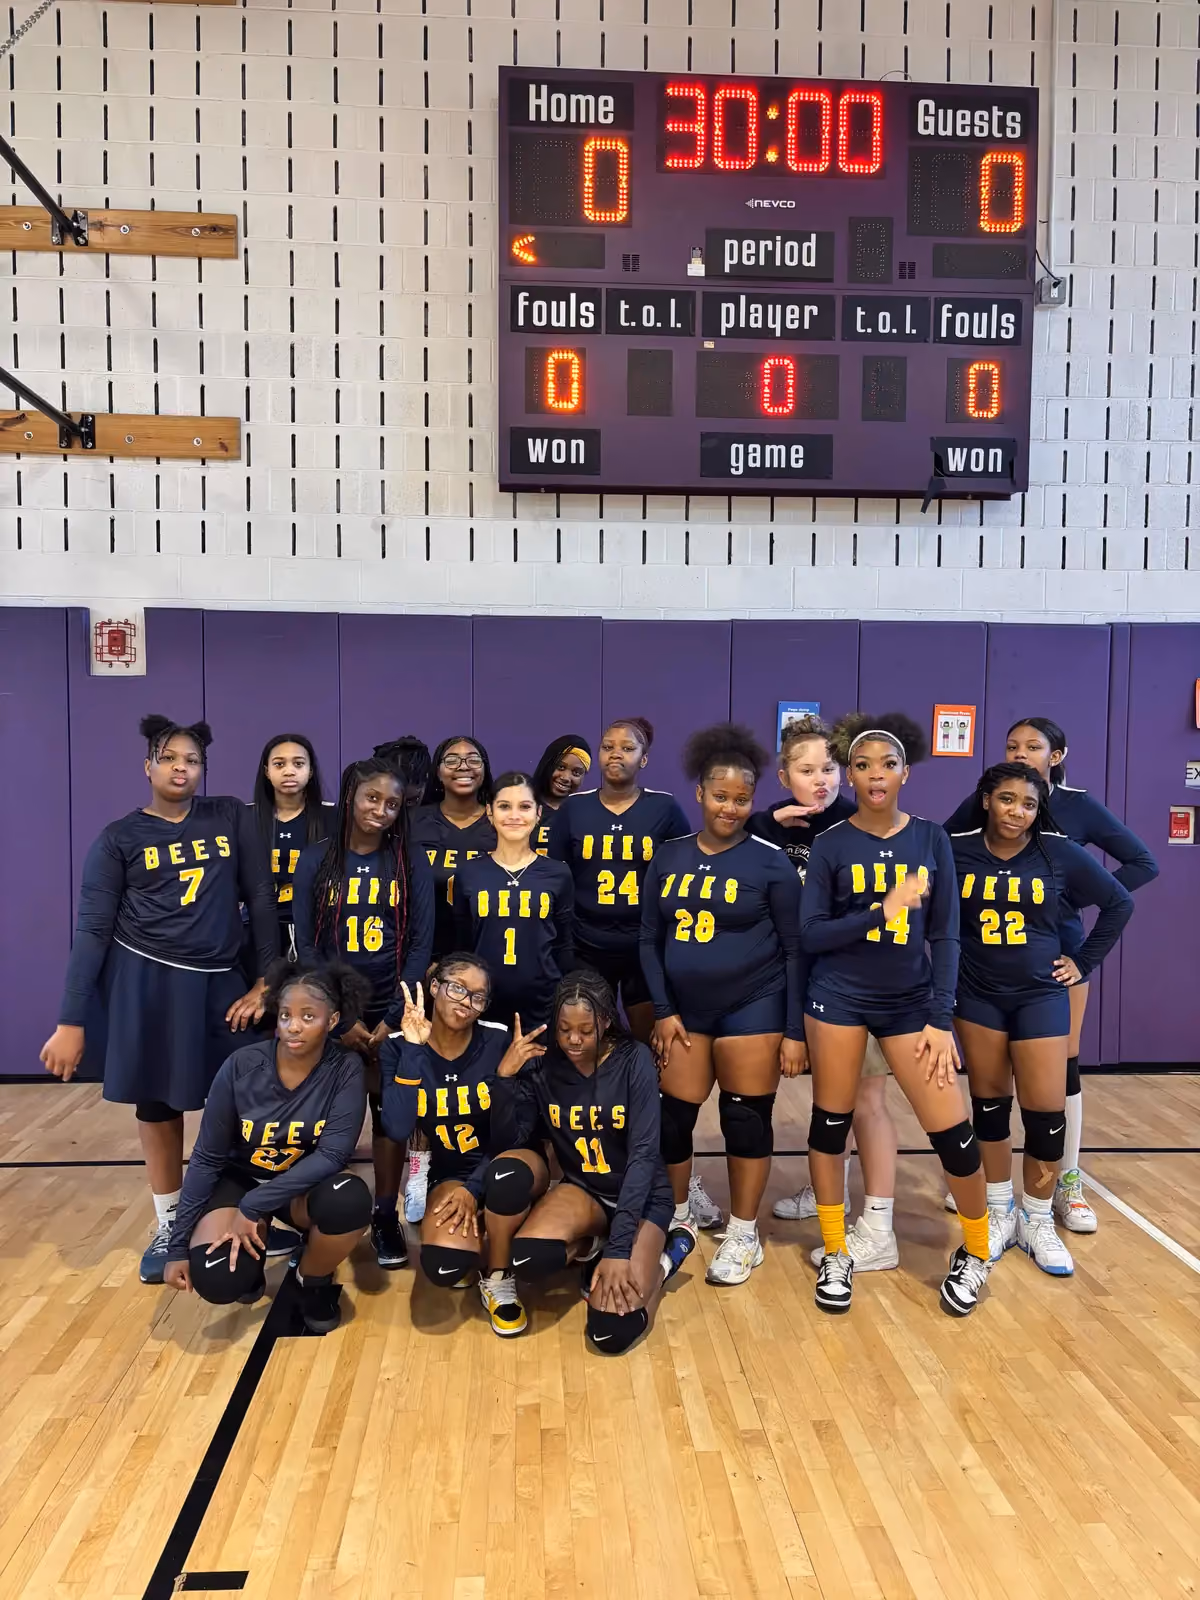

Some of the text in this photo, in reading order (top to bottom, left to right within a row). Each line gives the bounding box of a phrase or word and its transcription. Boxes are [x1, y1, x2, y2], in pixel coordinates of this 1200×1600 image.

[528, 83, 615, 125] Home
[916, 98, 1022, 139] Guests
[664, 84, 883, 175] 30:00
[583, 136, 629, 222] 0
[979, 151, 1024, 233] 0
[724, 232, 817, 273] period
[517, 292, 596, 328] fouls
[720, 294, 819, 337] player
[940, 303, 1016, 339] fouls
[546, 350, 580, 409] 0
[763, 357, 795, 414] 0
[967, 362, 999, 418] 0
[527, 437, 586, 464] won
[730, 442, 805, 476] game
[947, 446, 1003, 473] won
[143, 835, 231, 870] BEES
[178, 867, 205, 906] 7
[597, 869, 640, 906] 24
[346, 915, 384, 952] 16
[674, 908, 716, 943] 28
[979, 908, 1027, 945] 22
[503, 927, 517, 965] 1
[547, 1103, 626, 1130] BEES
[435, 1123, 480, 1154] 12
[574, 1136, 612, 1174] 11
